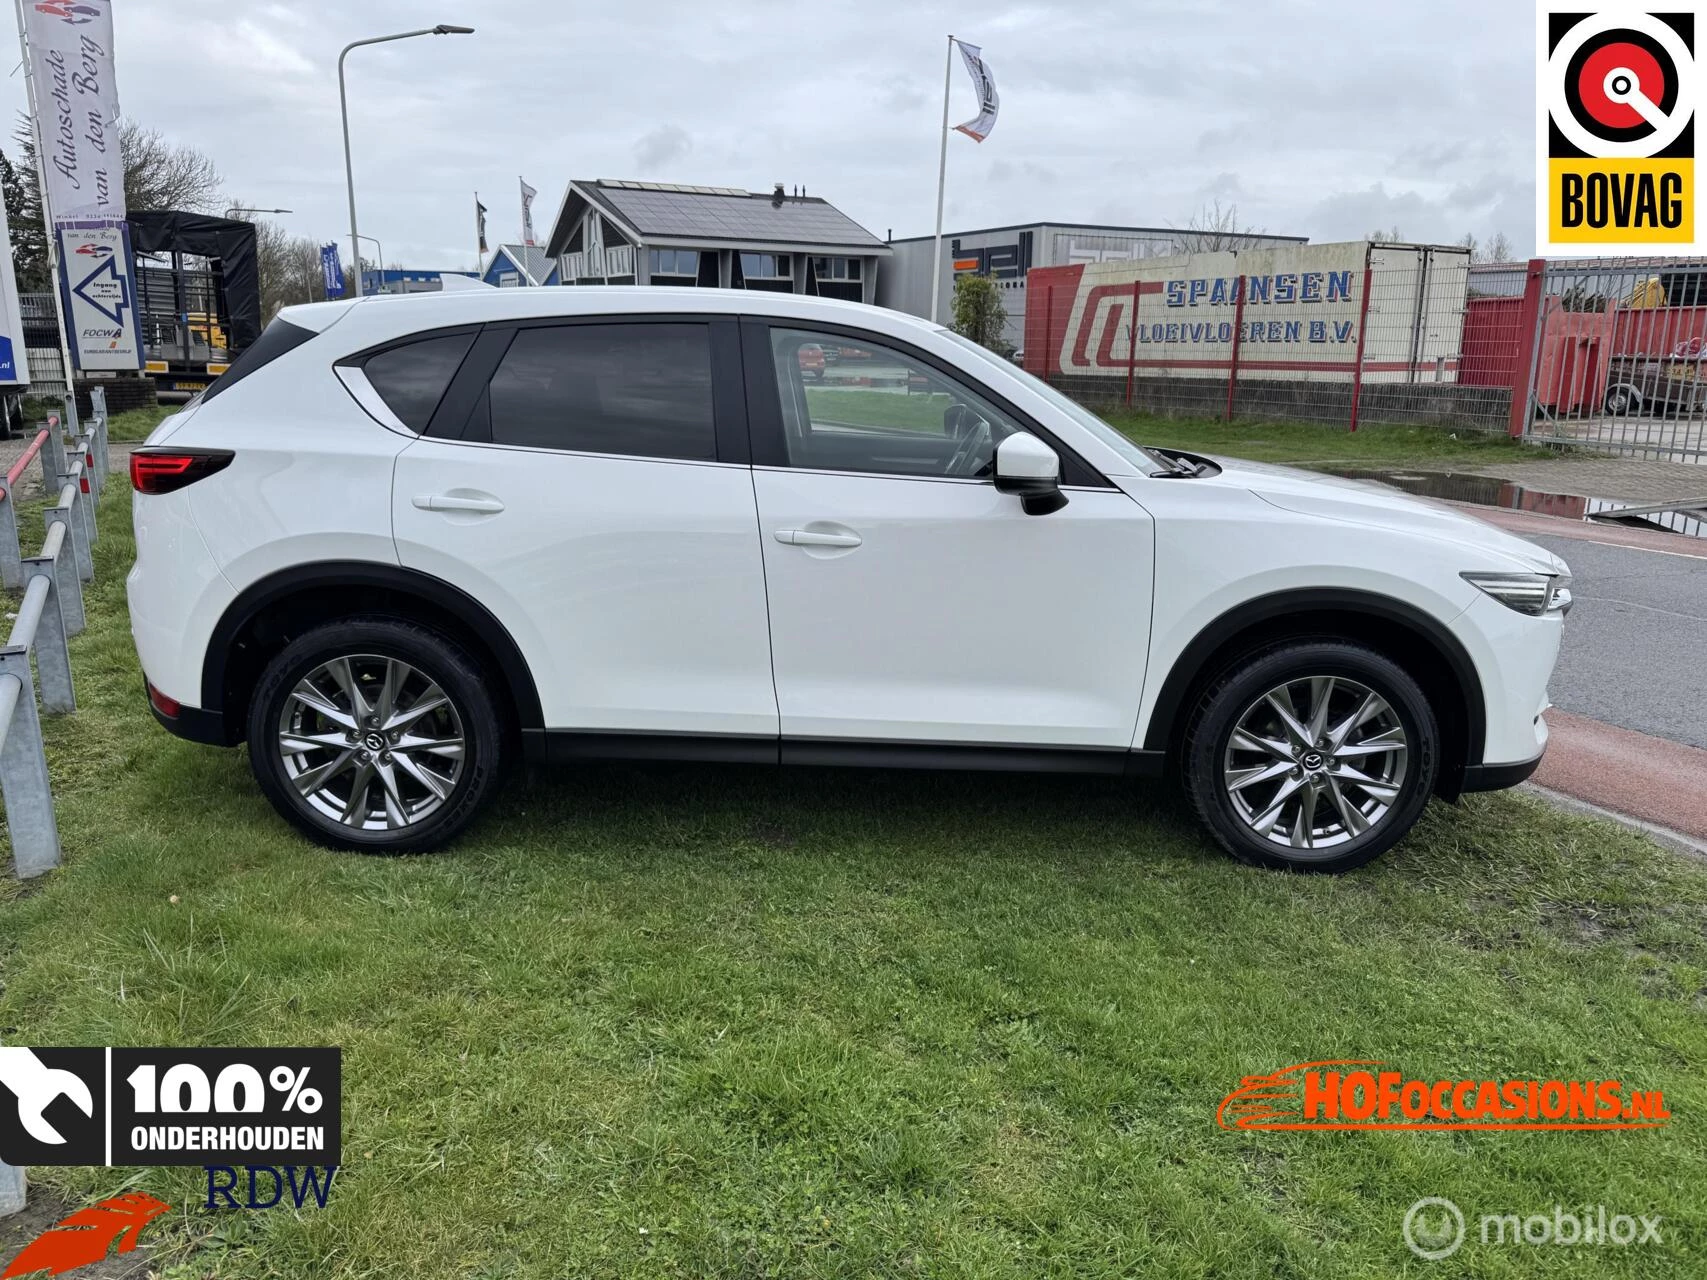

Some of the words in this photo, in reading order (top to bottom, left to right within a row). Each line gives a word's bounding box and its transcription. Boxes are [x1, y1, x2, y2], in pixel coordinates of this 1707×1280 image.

[72, 34, 105, 96] Berg
[45, 50, 80, 190] Autoschade
[85, 108, 106, 153] den
[95, 168, 110, 207] van
[1166, 270, 1354, 307] SPAANSEN
[82, 328, 122, 339] FOCWA
[1308, 320, 1357, 343] B.V.
